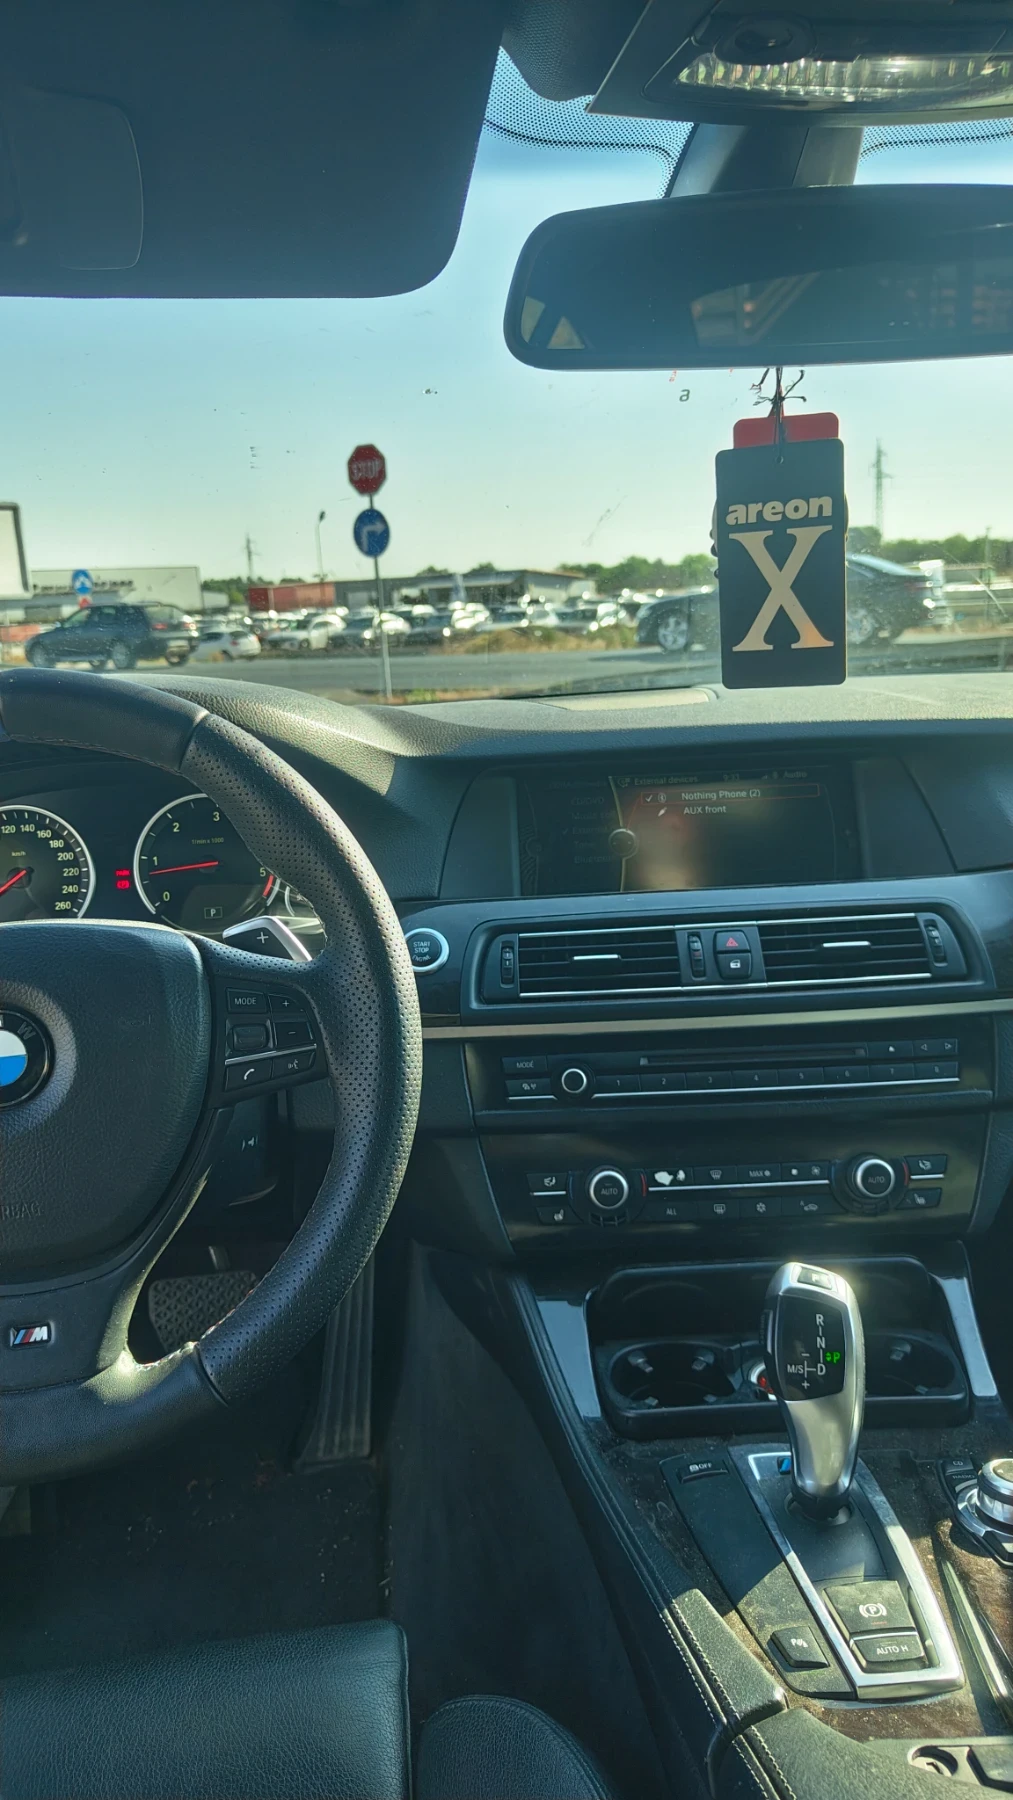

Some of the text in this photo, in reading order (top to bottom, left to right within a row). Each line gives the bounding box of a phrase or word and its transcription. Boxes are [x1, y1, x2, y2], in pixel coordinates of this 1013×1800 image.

[351, 459, 381, 480] STOP
[725, 495, 833, 526] areon
[728, 525, 835, 652] X
[634, 775, 698, 787] External devices
[681, 788, 761, 802] Nothing Phone (2)
[683, 804, 727, 815] AUX front
[213, 811, 220, 822] 3
[1, 823, 35, 834] 120 140
[173, 822, 180, 833] 2
[36, 829, 52, 839] 160
[49, 839, 65, 848] 180
[57, 852, 74, 861] 200
[153, 856, 158, 866] 1
[63, 867, 79, 877] 220
[259, 867, 266, 877] 5
[62, 884, 79, 894] 240
[163, 891, 170, 902] 0
[54, 901, 71, 910] 260
[210, 908, 216, 917] P
[234, 997, 257, 1005] MODE
[516, 1060, 534, 1069] MODE
[868, 1175, 885, 1183] AUTO
[600, 1187, 618, 1196] AUTO
[815, 1313, 824, 1326] R
[816, 1336, 826, 1349] N
[833, 1351, 841, 1364] P
[787, 1364, 804, 1374] M/S
[817, 1363, 826, 1375] D
[876, 1645, 909, 1655] AUTO H
